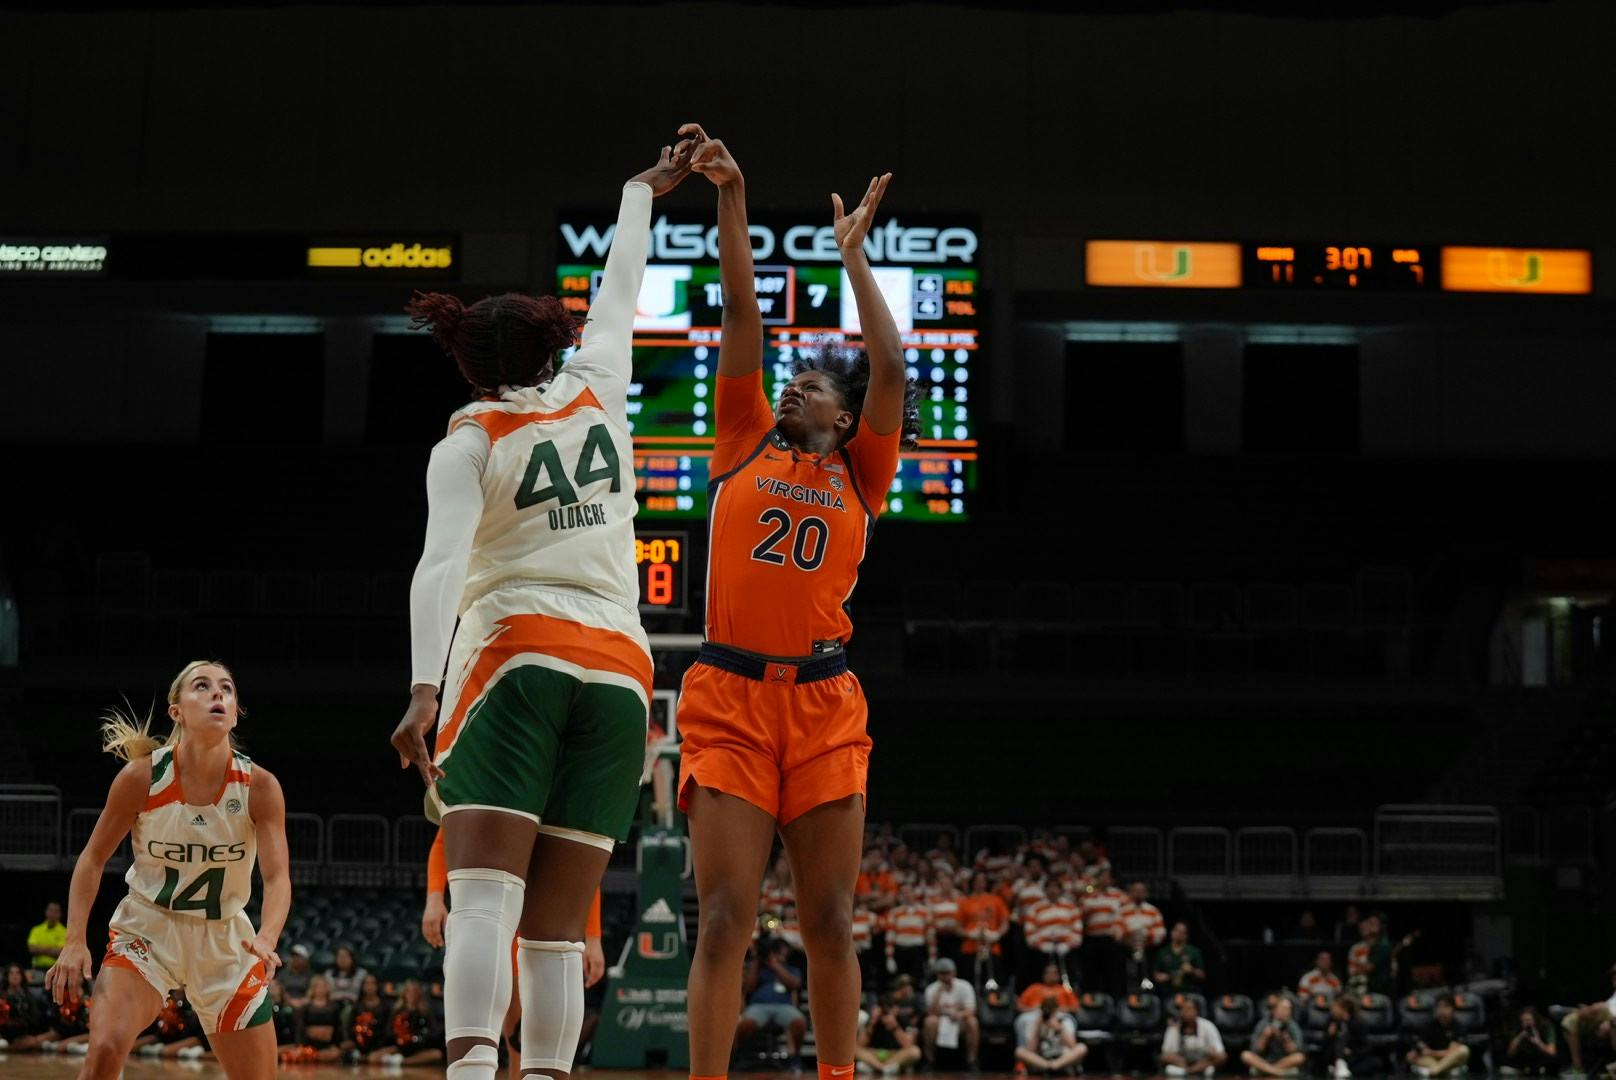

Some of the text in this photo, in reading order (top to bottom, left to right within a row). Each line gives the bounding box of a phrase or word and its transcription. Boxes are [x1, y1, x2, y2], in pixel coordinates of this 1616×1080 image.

[362, 243, 452, 269] adidas
[807, 284, 828, 308] 7
[513, 423, 622, 511] 44
[755, 475, 847, 513] VIRGINIA
[547, 503, 607, 531] OLDACRE
[751, 507, 830, 572] 20
[647, 563, 673, 606] 8
[154, 866, 226, 920] 14
